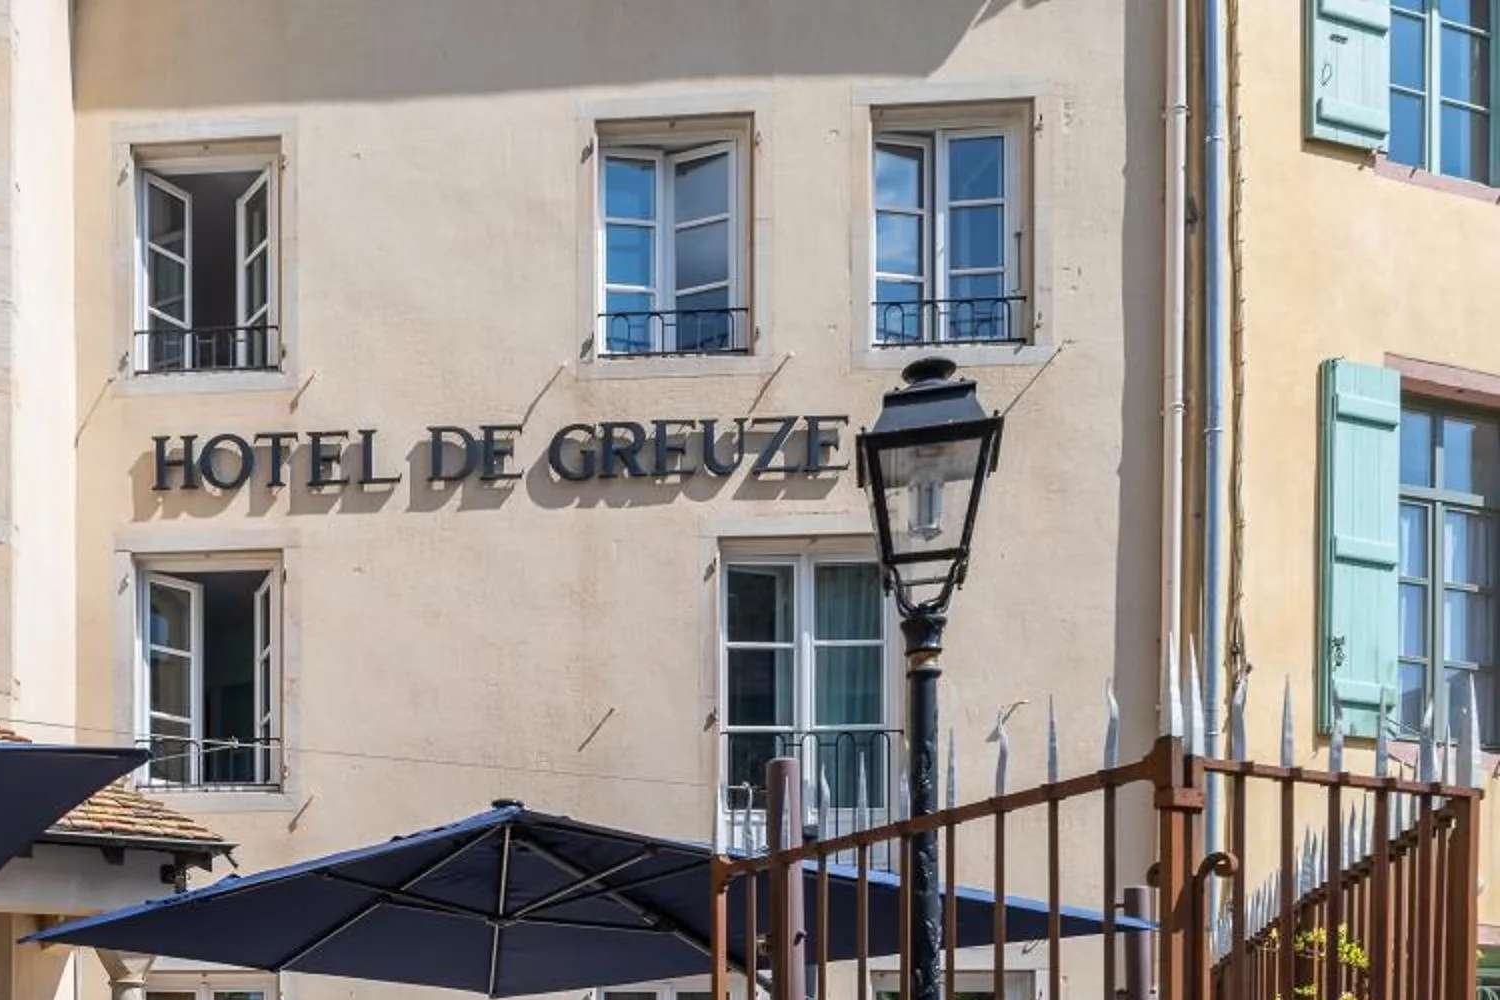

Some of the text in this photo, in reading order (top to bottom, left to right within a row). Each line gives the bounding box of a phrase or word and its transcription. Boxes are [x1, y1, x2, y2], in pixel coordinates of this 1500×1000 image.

[152, 414, 850, 491] HOTEL DE GREUZE
